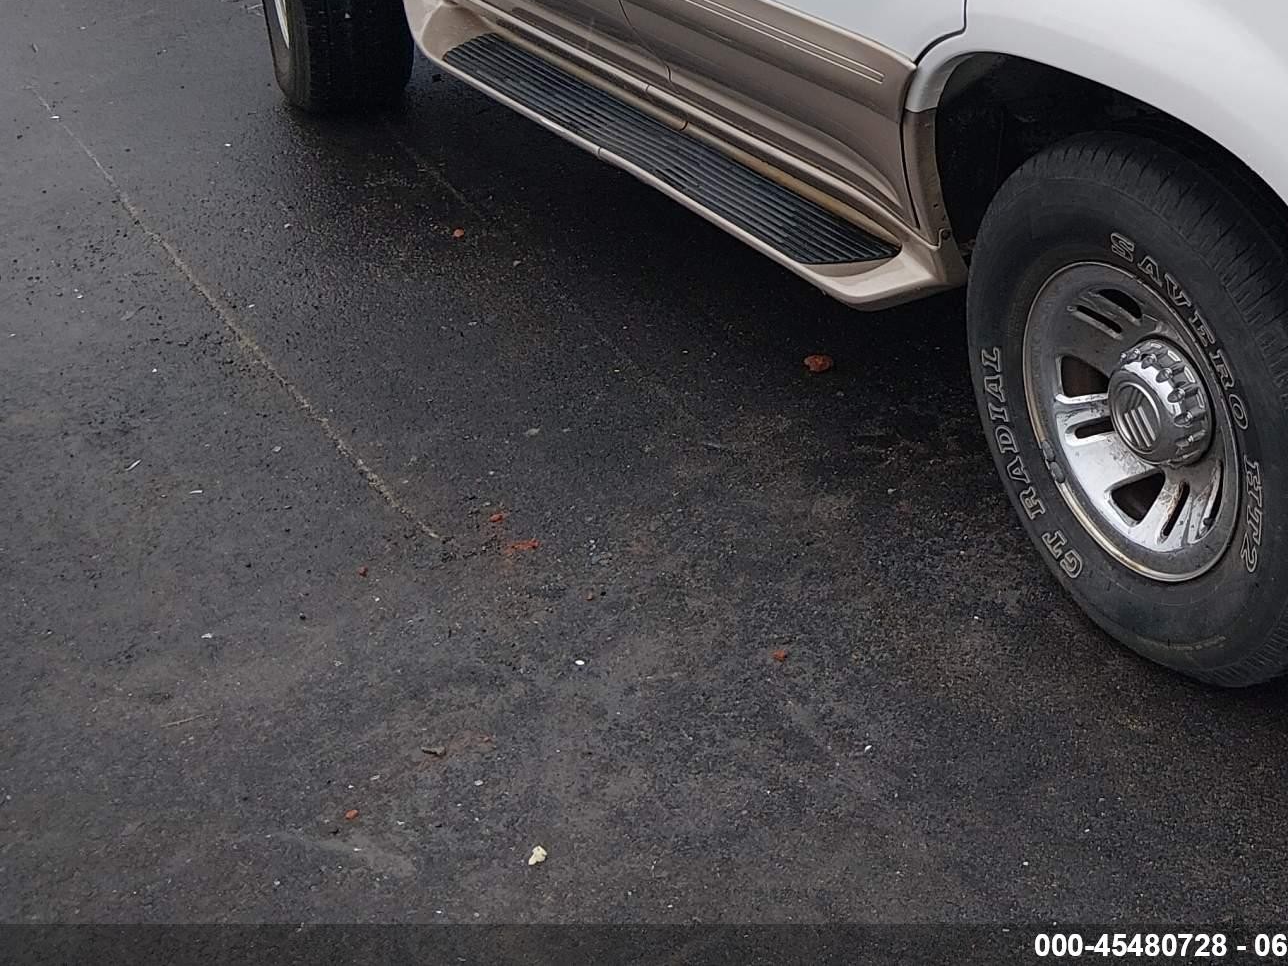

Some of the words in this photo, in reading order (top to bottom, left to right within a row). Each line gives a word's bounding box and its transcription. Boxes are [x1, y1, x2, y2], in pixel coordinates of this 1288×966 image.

[981, 346, 1046, 521] RADIAL
[1110, 232, 1249, 430] SAVERO
[1240, 455, 1264, 574] HT2
[1042, 529, 1083, 578] GT
